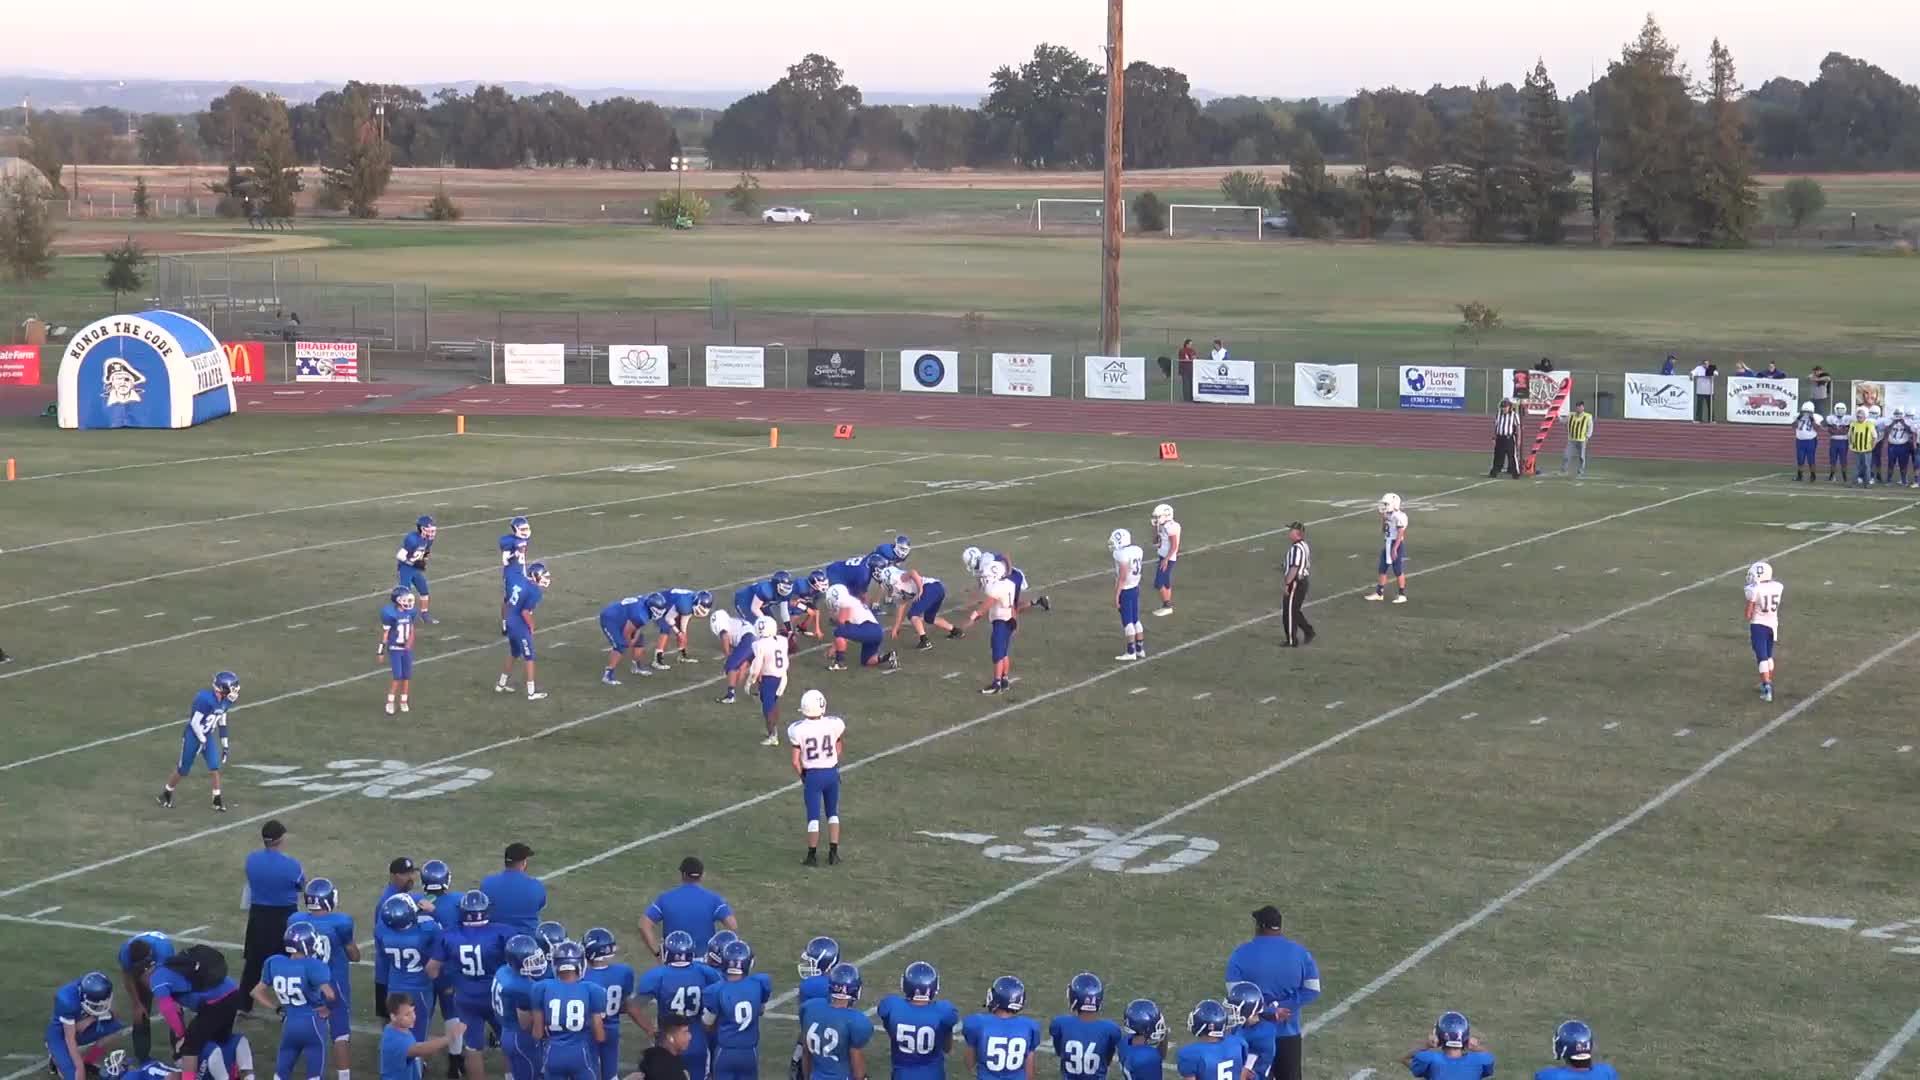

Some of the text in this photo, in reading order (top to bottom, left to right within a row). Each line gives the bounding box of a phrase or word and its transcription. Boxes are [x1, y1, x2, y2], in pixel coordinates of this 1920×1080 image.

[70, 322, 173, 360] HONOR THE CODE
[296, 343, 356, 351] BRADFORD
[1103, 373, 1128, 384] FWC
[1424, 369, 1459, 380] Plumas
[1430, 377, 1453, 386] Lake
[1641, 392, 1669, 406] Realty
[1728, 384, 1753, 398] LINDA
[1735, 409, 1791, 417] ASSOCIATION
[839, 426, 848, 434] G
[1163, 443, 1176, 456] 10
[1762, 593, 1779, 613] 15
[774, 649, 783, 669] 6
[805, 735, 834, 760] 24
[384, 947, 424, 973] 72
[459, 944, 485, 977] 51
[273, 975, 307, 1006] 85
[670, 985, 702, 1017] 43
[548, 998, 585, 1032] 18
[734, 1000, 753, 1032] 9
[806, 1022, 840, 1062] 62
[896, 1023, 936, 1055] 50
[986, 1036, 1028, 1072] 58
[1065, 1039, 1101, 1075] 36
